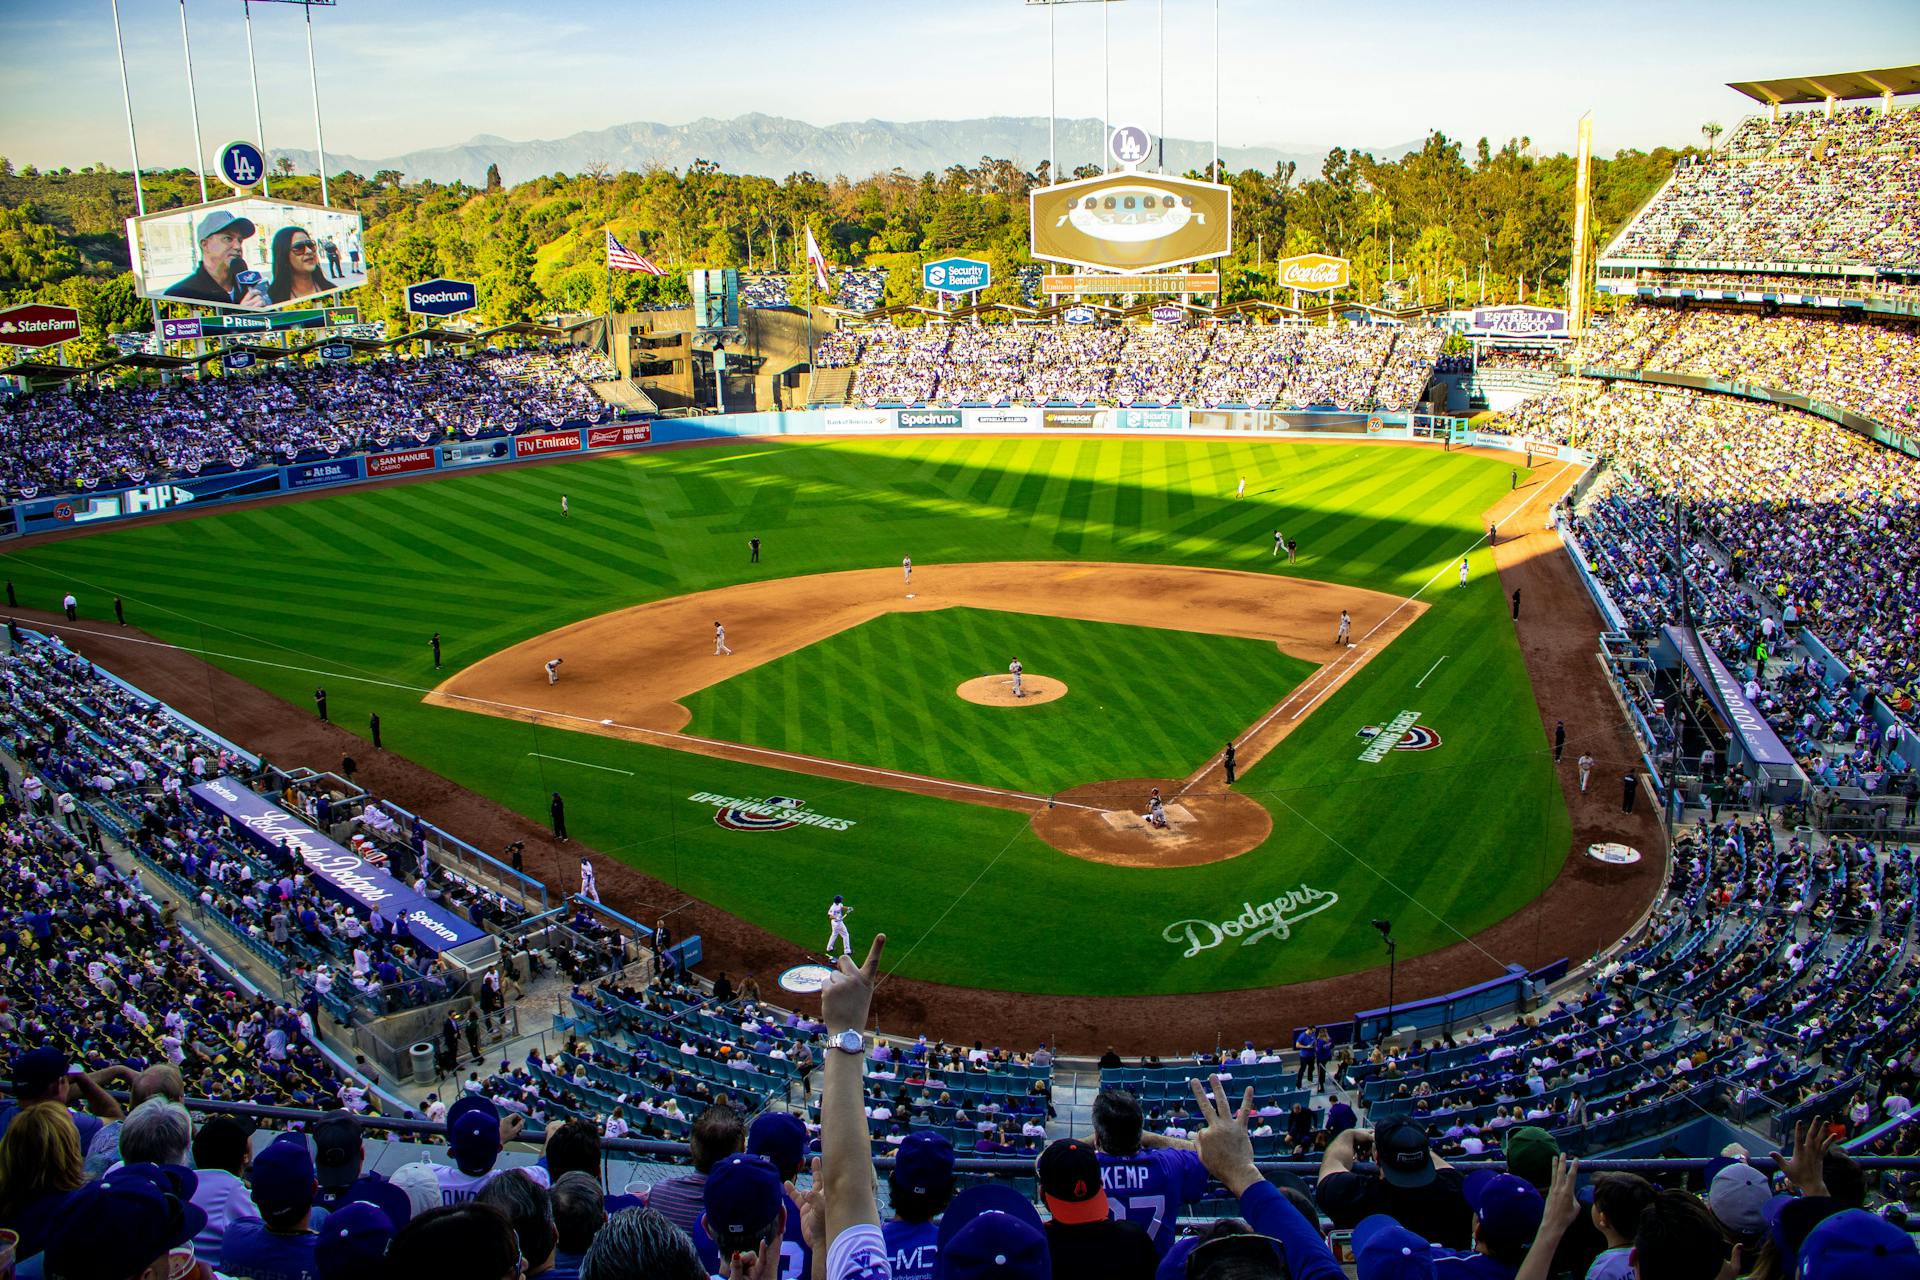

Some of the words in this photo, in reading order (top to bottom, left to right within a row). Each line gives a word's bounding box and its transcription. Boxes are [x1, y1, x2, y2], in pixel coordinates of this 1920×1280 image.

[1120, 130, 1140, 159] LA
[231, 150, 255, 180] LA
[948, 265, 983, 276] Security
[1660, 260, 1721, 269] DODGER
[1732, 262, 1799, 271] STADIUM
[1810, 265, 1843, 273] CLUB
[949, 275, 979, 285] Benefit
[413, 291, 468, 306] Spectrum
[1154, 310, 1179, 318] DASANI
[1484, 311, 1555, 323] ESTRELLA
[177, 321, 199, 330] Security
[1490, 321, 1548, 331] JALISCO
[901, 413, 956, 426] Spectrum
[517, 441, 535, 452] Fly
[535, 435, 579, 450] Emirates
[380, 457, 396, 465] SAN
[397, 452, 430, 463] MANUEL
[313, 467, 325, 477] At
[325, 465, 341, 475] Bat
[57, 505, 72, 517] 76
[206, 781, 238, 802] Spectrum
[687, 791, 782, 815] OPENING
[774, 808, 857, 831] SERIES
[320, 856, 393, 902] Dodgers
[410, 910, 457, 942] Spectrum
[1162, 884, 1339, 959] Dodgers
[1100, 1165, 1149, 1190] KEMP
